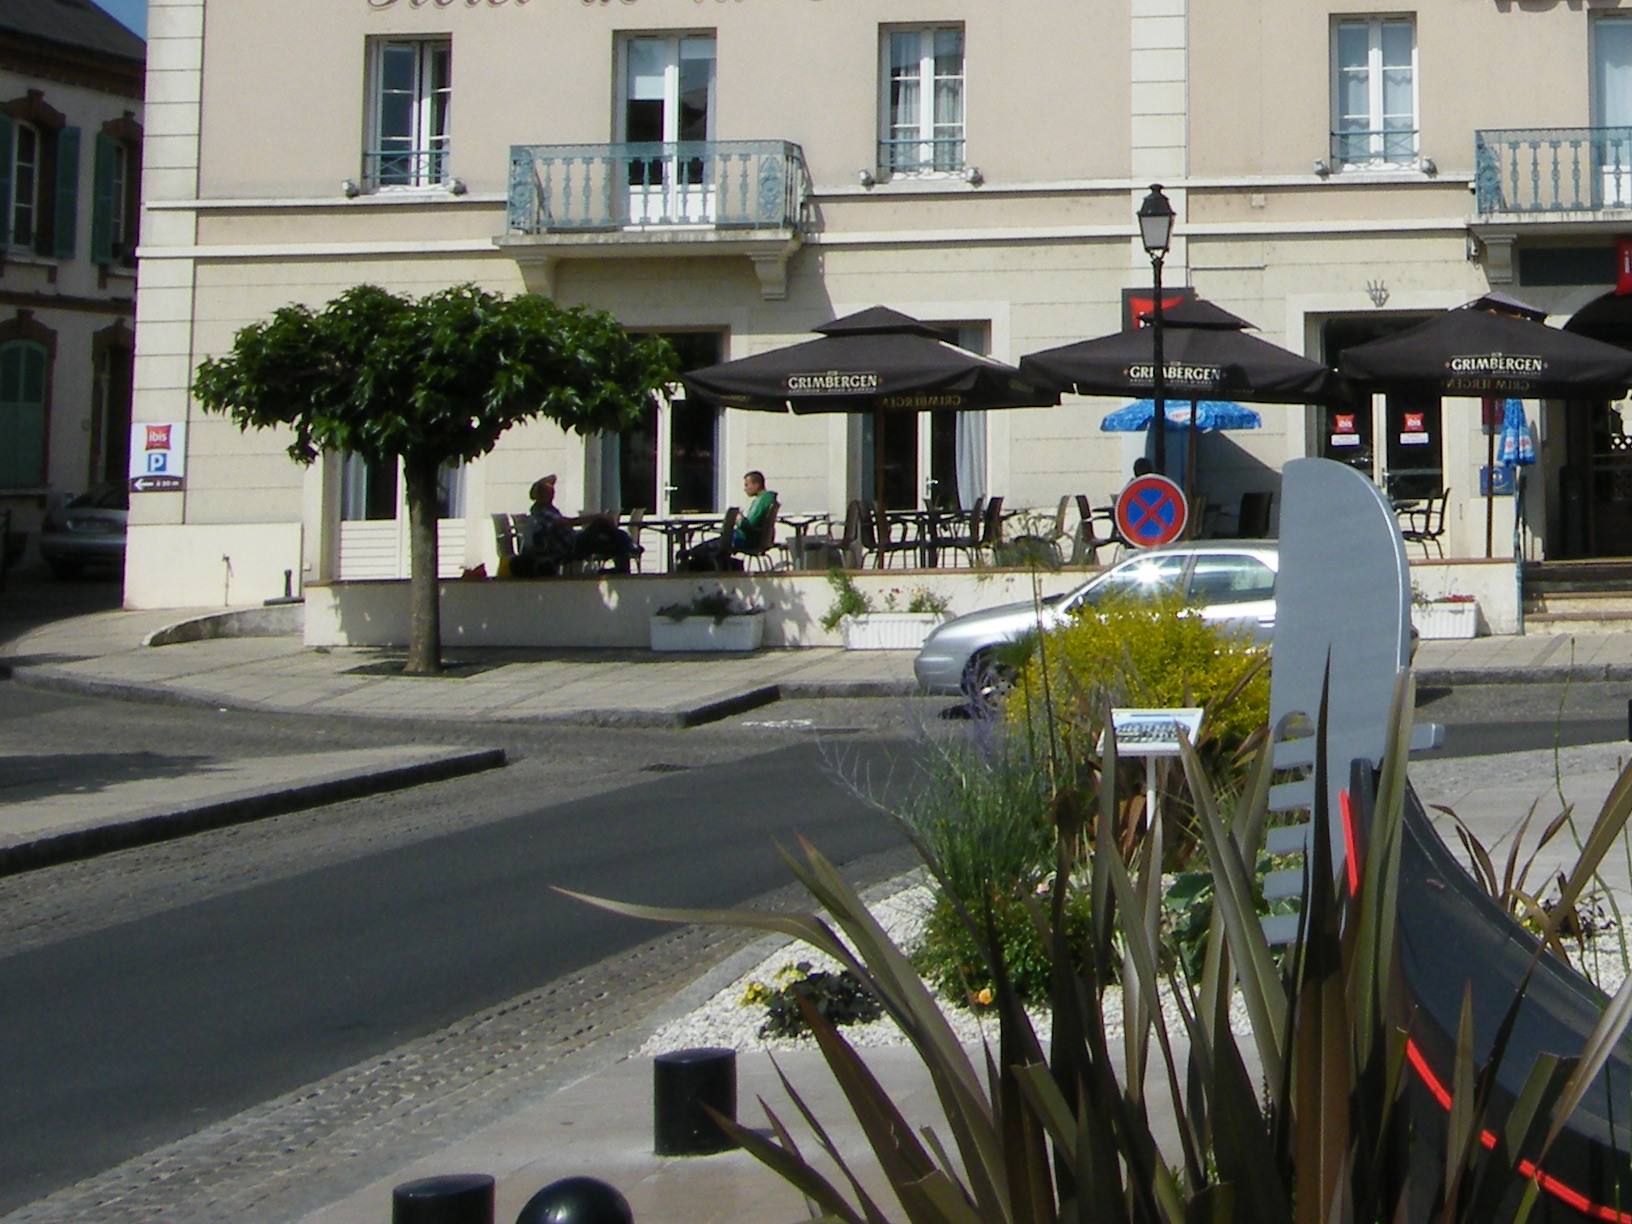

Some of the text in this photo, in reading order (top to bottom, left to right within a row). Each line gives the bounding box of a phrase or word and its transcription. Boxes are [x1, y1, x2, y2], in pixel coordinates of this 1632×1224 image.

[1451, 358, 1542, 371] GRIMBERGEN
[787, 374, 877, 389] GRIMBERGEN
[150, 454, 164, 471] P
